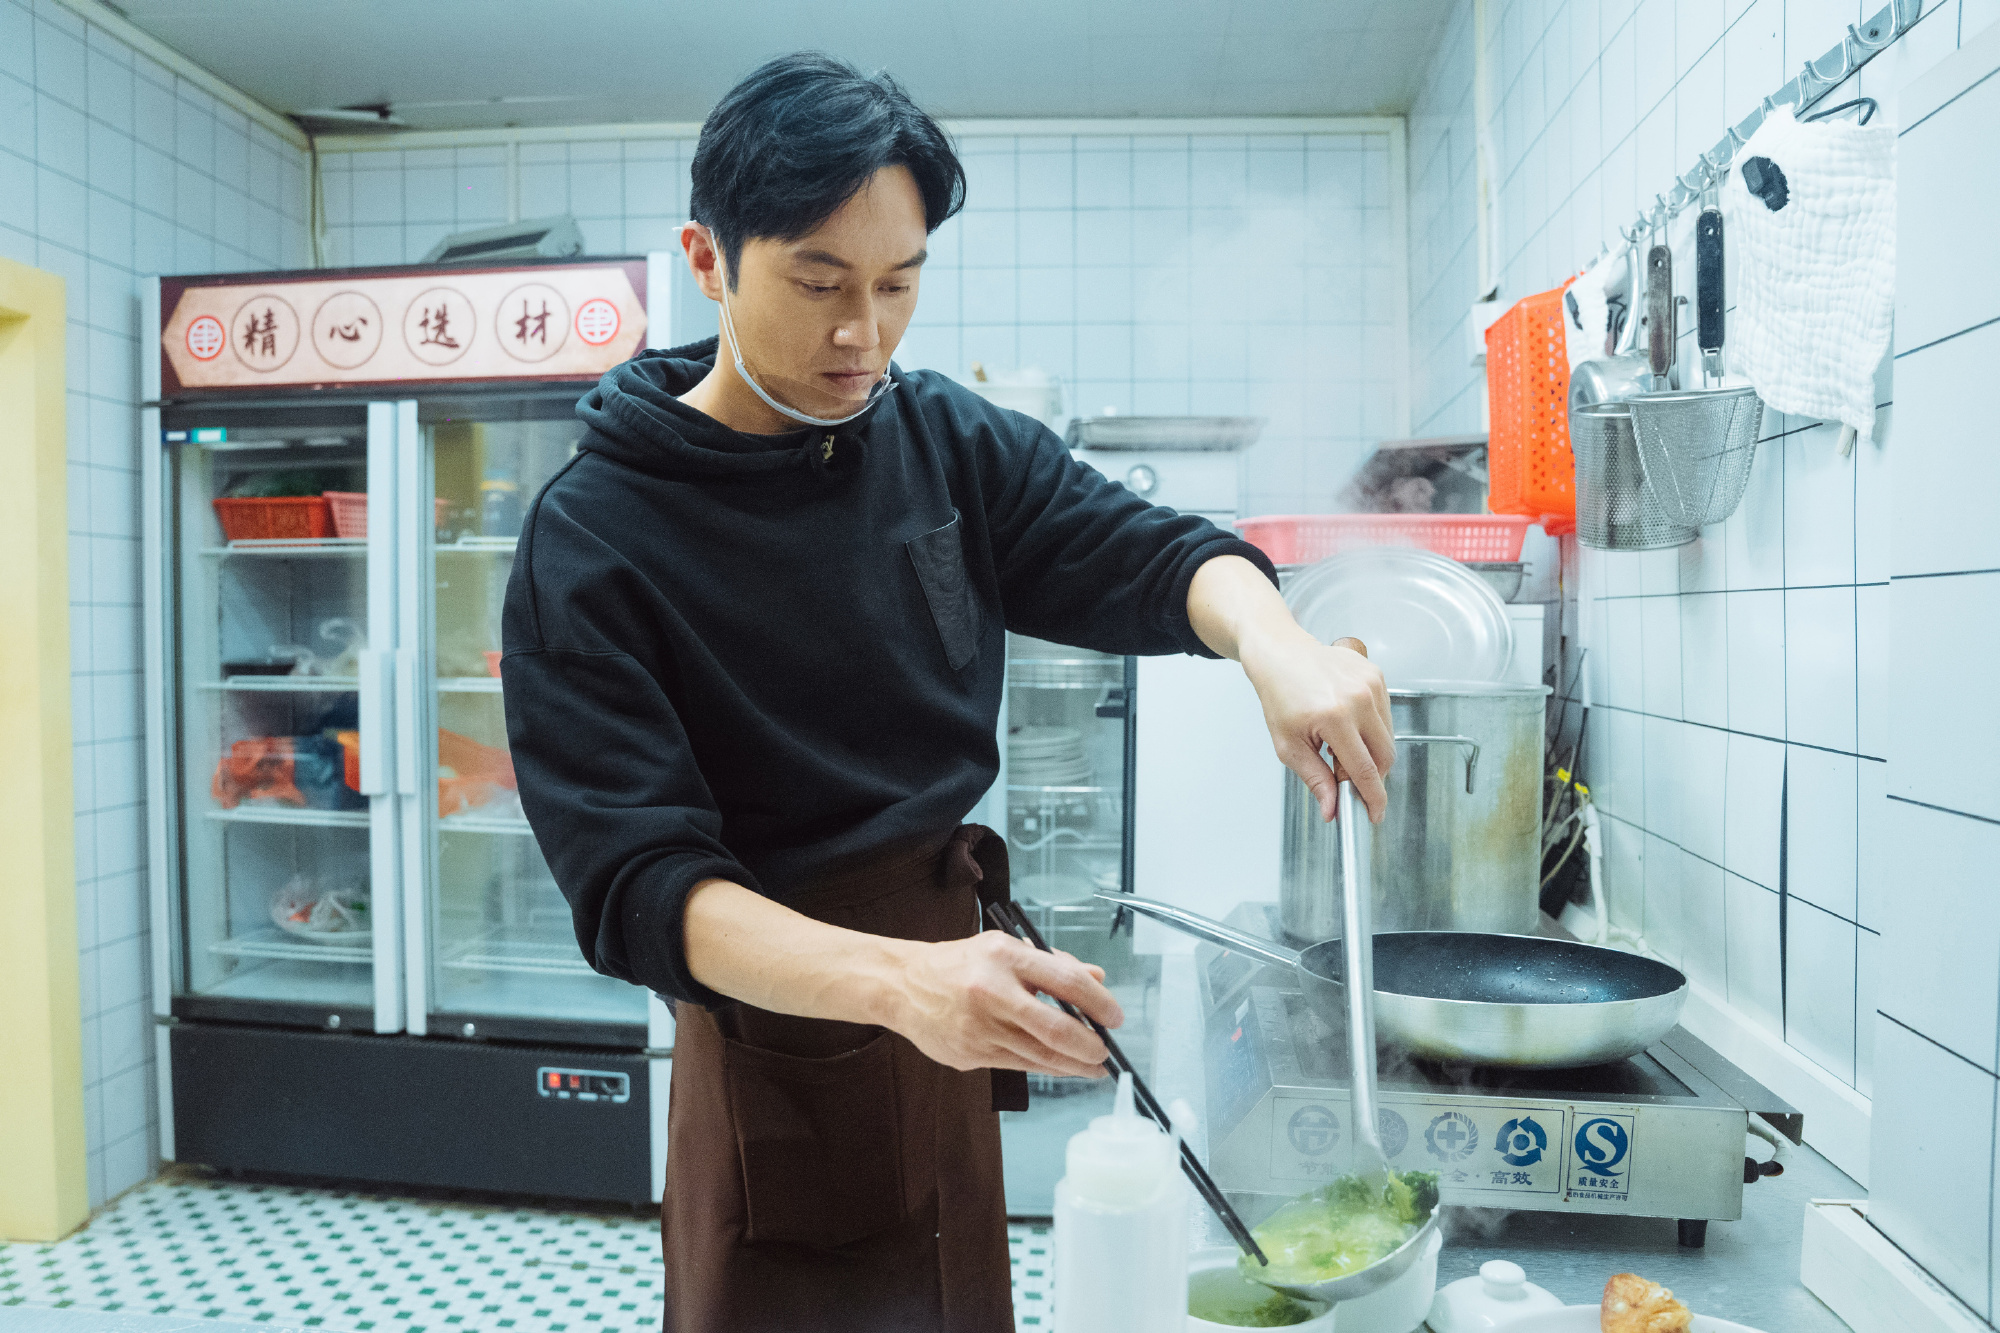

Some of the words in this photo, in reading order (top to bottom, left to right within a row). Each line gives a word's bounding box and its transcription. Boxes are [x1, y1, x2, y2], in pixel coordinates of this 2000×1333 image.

[243, 298, 551, 357] 精心选材
[1490, 1170, 1533, 1186] 高效
[1578, 1176, 1619, 1189] 质量安全
